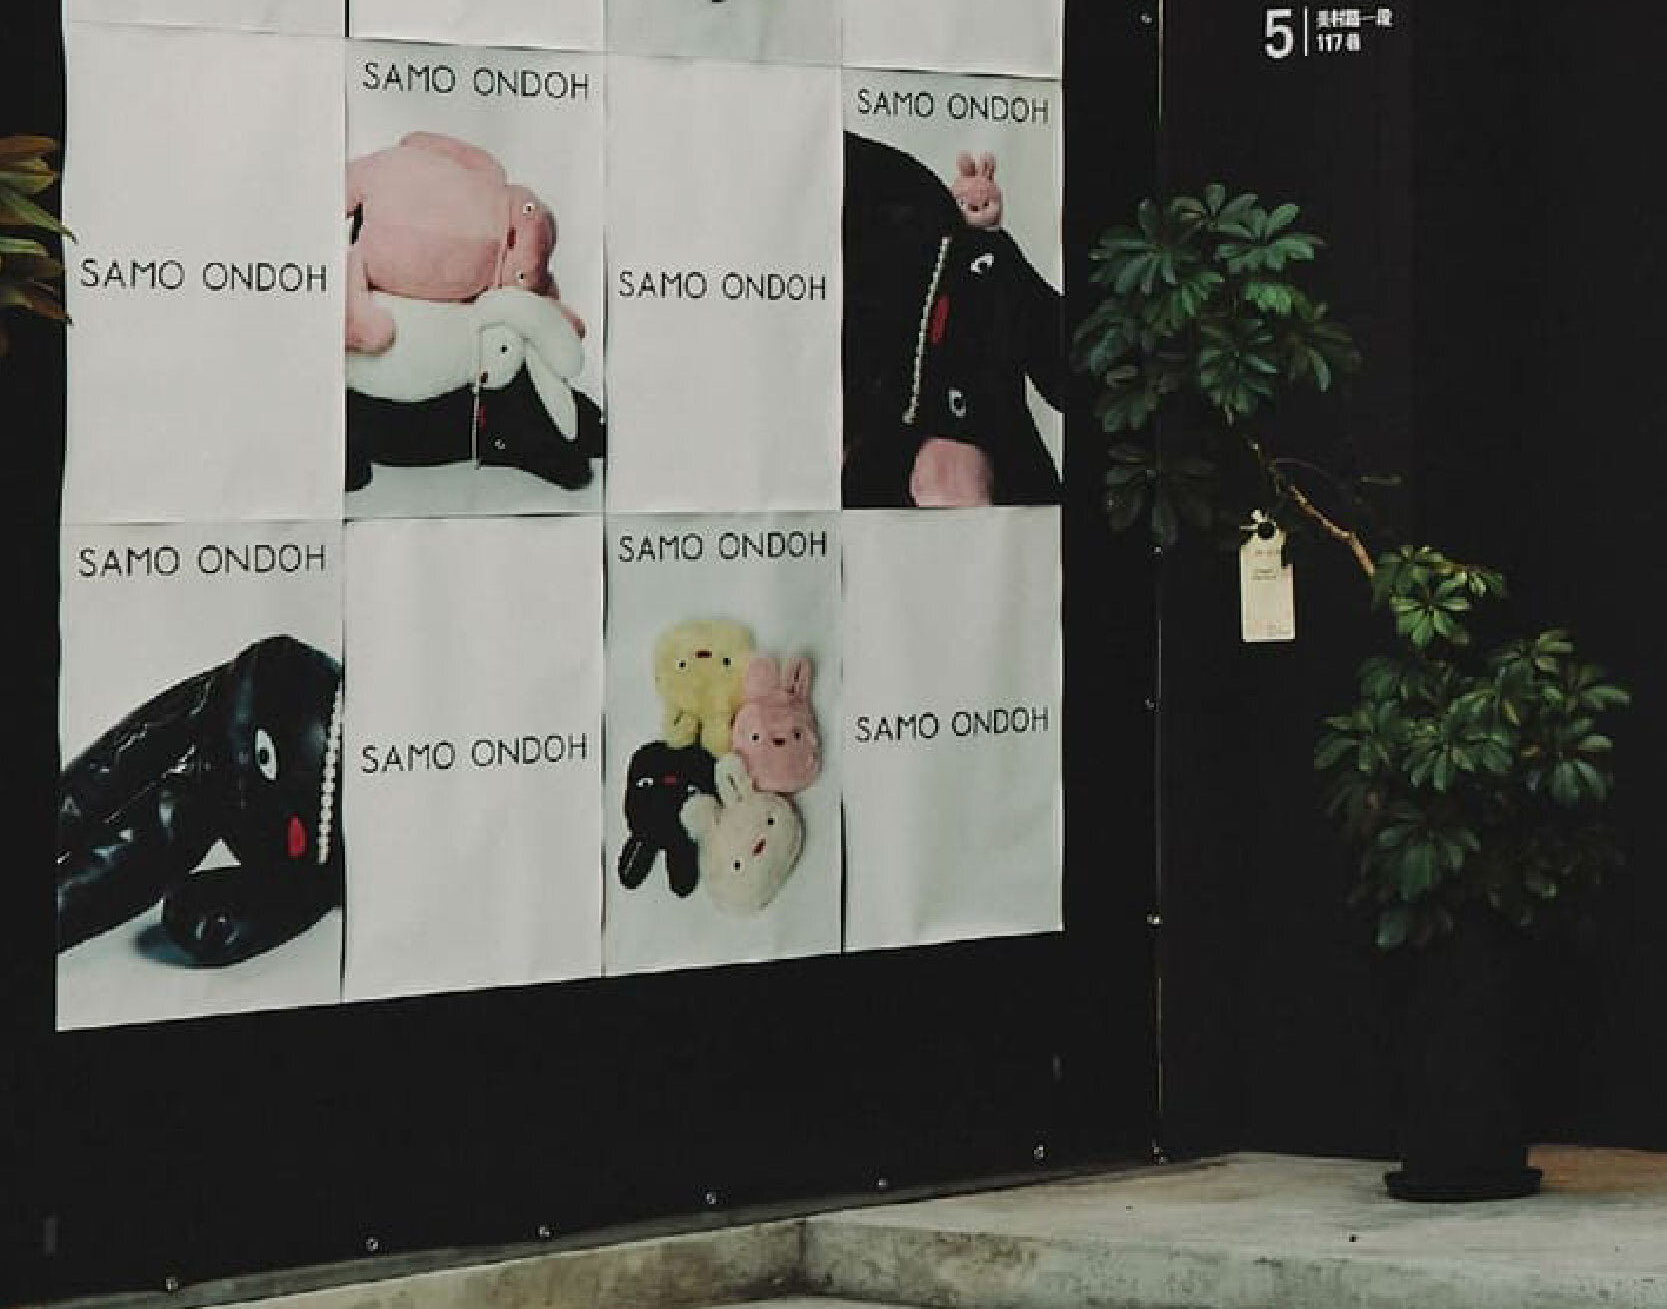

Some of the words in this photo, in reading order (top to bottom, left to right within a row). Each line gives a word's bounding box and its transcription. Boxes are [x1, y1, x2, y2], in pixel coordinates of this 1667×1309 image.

[1265, 8, 1294, 59] 5
[362, 62, 456, 94] SAMO
[473, 66, 588, 100] ONDOH
[857, 88, 934, 119] SAMO
[946, 92, 1049, 125] ONDOH
[80, 257, 186, 292] SAMO
[202, 262, 327, 292] ONDOH
[617, 269, 708, 299] SAMO
[720, 271, 826, 301] ONDOH
[78, 544, 181, 579] SAMO
[195, 542, 327, 574] ONDOH
[617, 532, 703, 563] SAMO
[718, 530, 828, 560] ONDOH
[854, 711, 941, 744] SAMO
[951, 706, 1049, 737] ONDOH
[360, 739, 456, 774] SAMO
[471, 732, 588, 767] ONDOH
